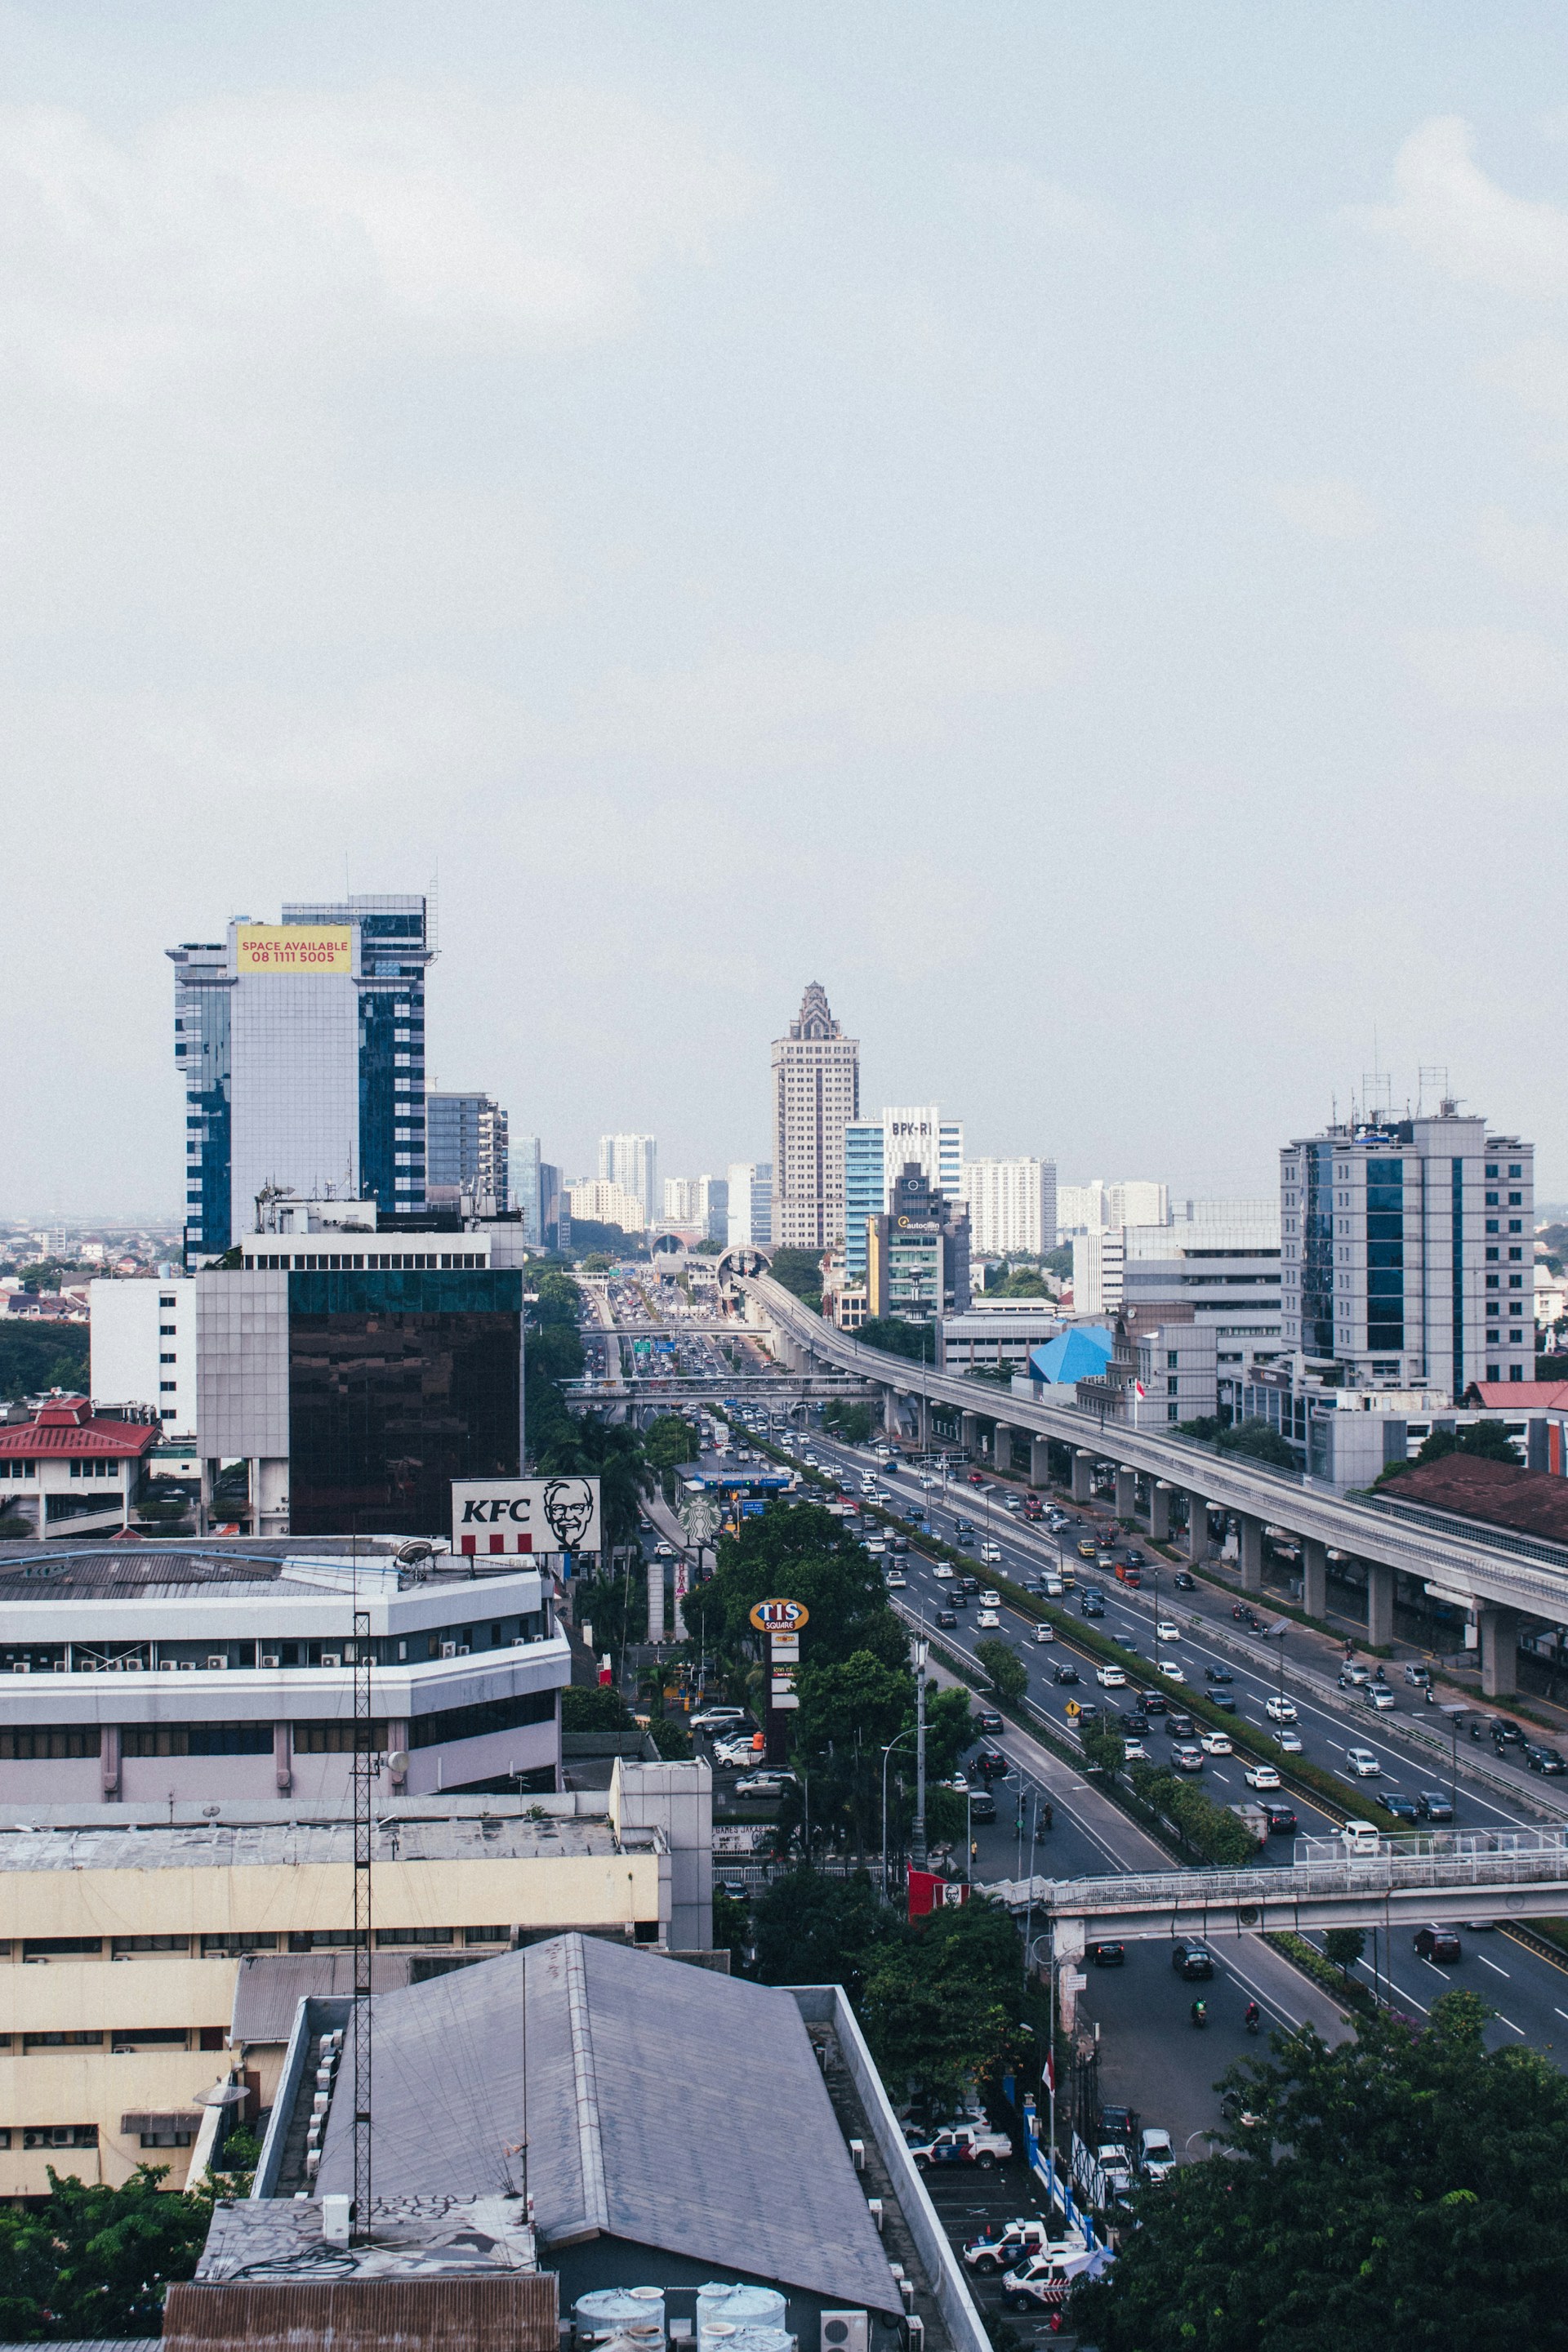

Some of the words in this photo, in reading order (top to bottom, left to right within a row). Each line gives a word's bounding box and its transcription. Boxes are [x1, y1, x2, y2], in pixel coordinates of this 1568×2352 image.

[242, 942, 281, 951] SPACE
[283, 942, 348, 951] AVAILABLE
[252, 951, 270, 962] 08
[274, 951, 296, 962] 1111
[300, 951, 335, 962] 5005
[892, 1121, 932, 1136] BPK-RI
[906, 1221, 940, 1229] autocillin
[461, 1498, 531, 1523] KFC
[760, 1603, 800, 1621] TIS
[766, 1621, 794, 1629] SQUARE
[715, 1826, 738, 1834] GAMES
